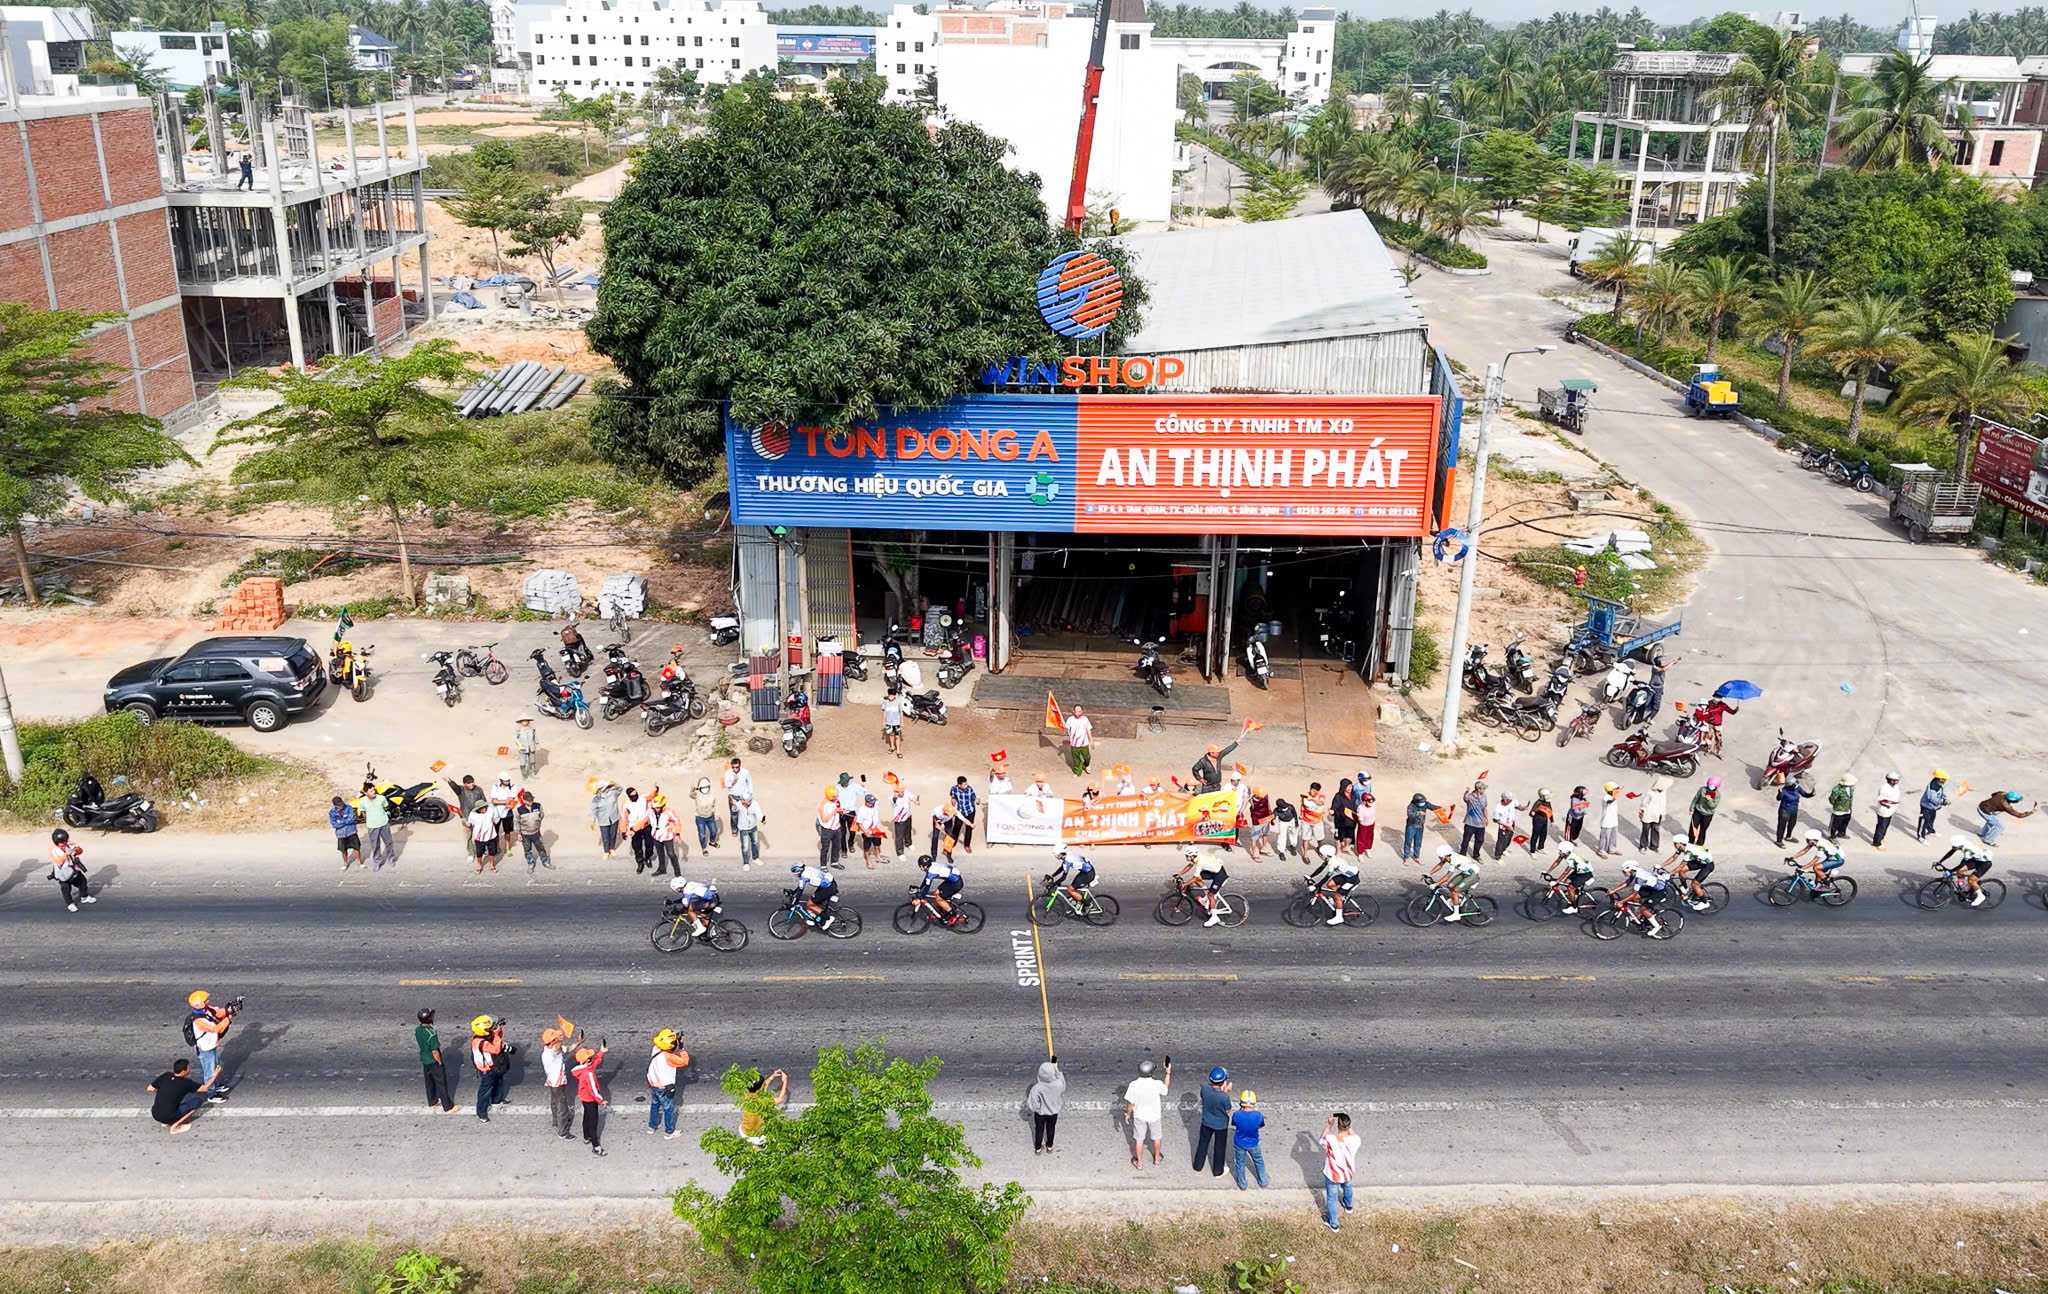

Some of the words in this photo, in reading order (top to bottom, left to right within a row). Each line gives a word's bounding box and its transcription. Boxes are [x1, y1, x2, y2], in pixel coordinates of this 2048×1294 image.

[1155, 413, 1206, 434] CÔNG
[1210, 418, 1232, 434] TY
[1240, 418, 1289, 434] TNHH
[1296, 418, 1322, 434] TM
[896, 428, 1019, 461] DONG
[1026, 430, 1061, 462] A
[1096, 448, 1157, 487] AN
[1168, 448, 1292, 498] THỊNH
[1302, 437, 1409, 488] PHÁT
[756, 474, 849, 494] THƯƠNG
[855, 472, 899, 498] HIỆU
[905, 474, 965, 498] QUỐC
[973, 479, 1009, 497] GIA
[1063, 816, 1085, 828] AN
[1010, 929, 1032, 937] 2
[1012, 938, 1041, 986] SPRINT
